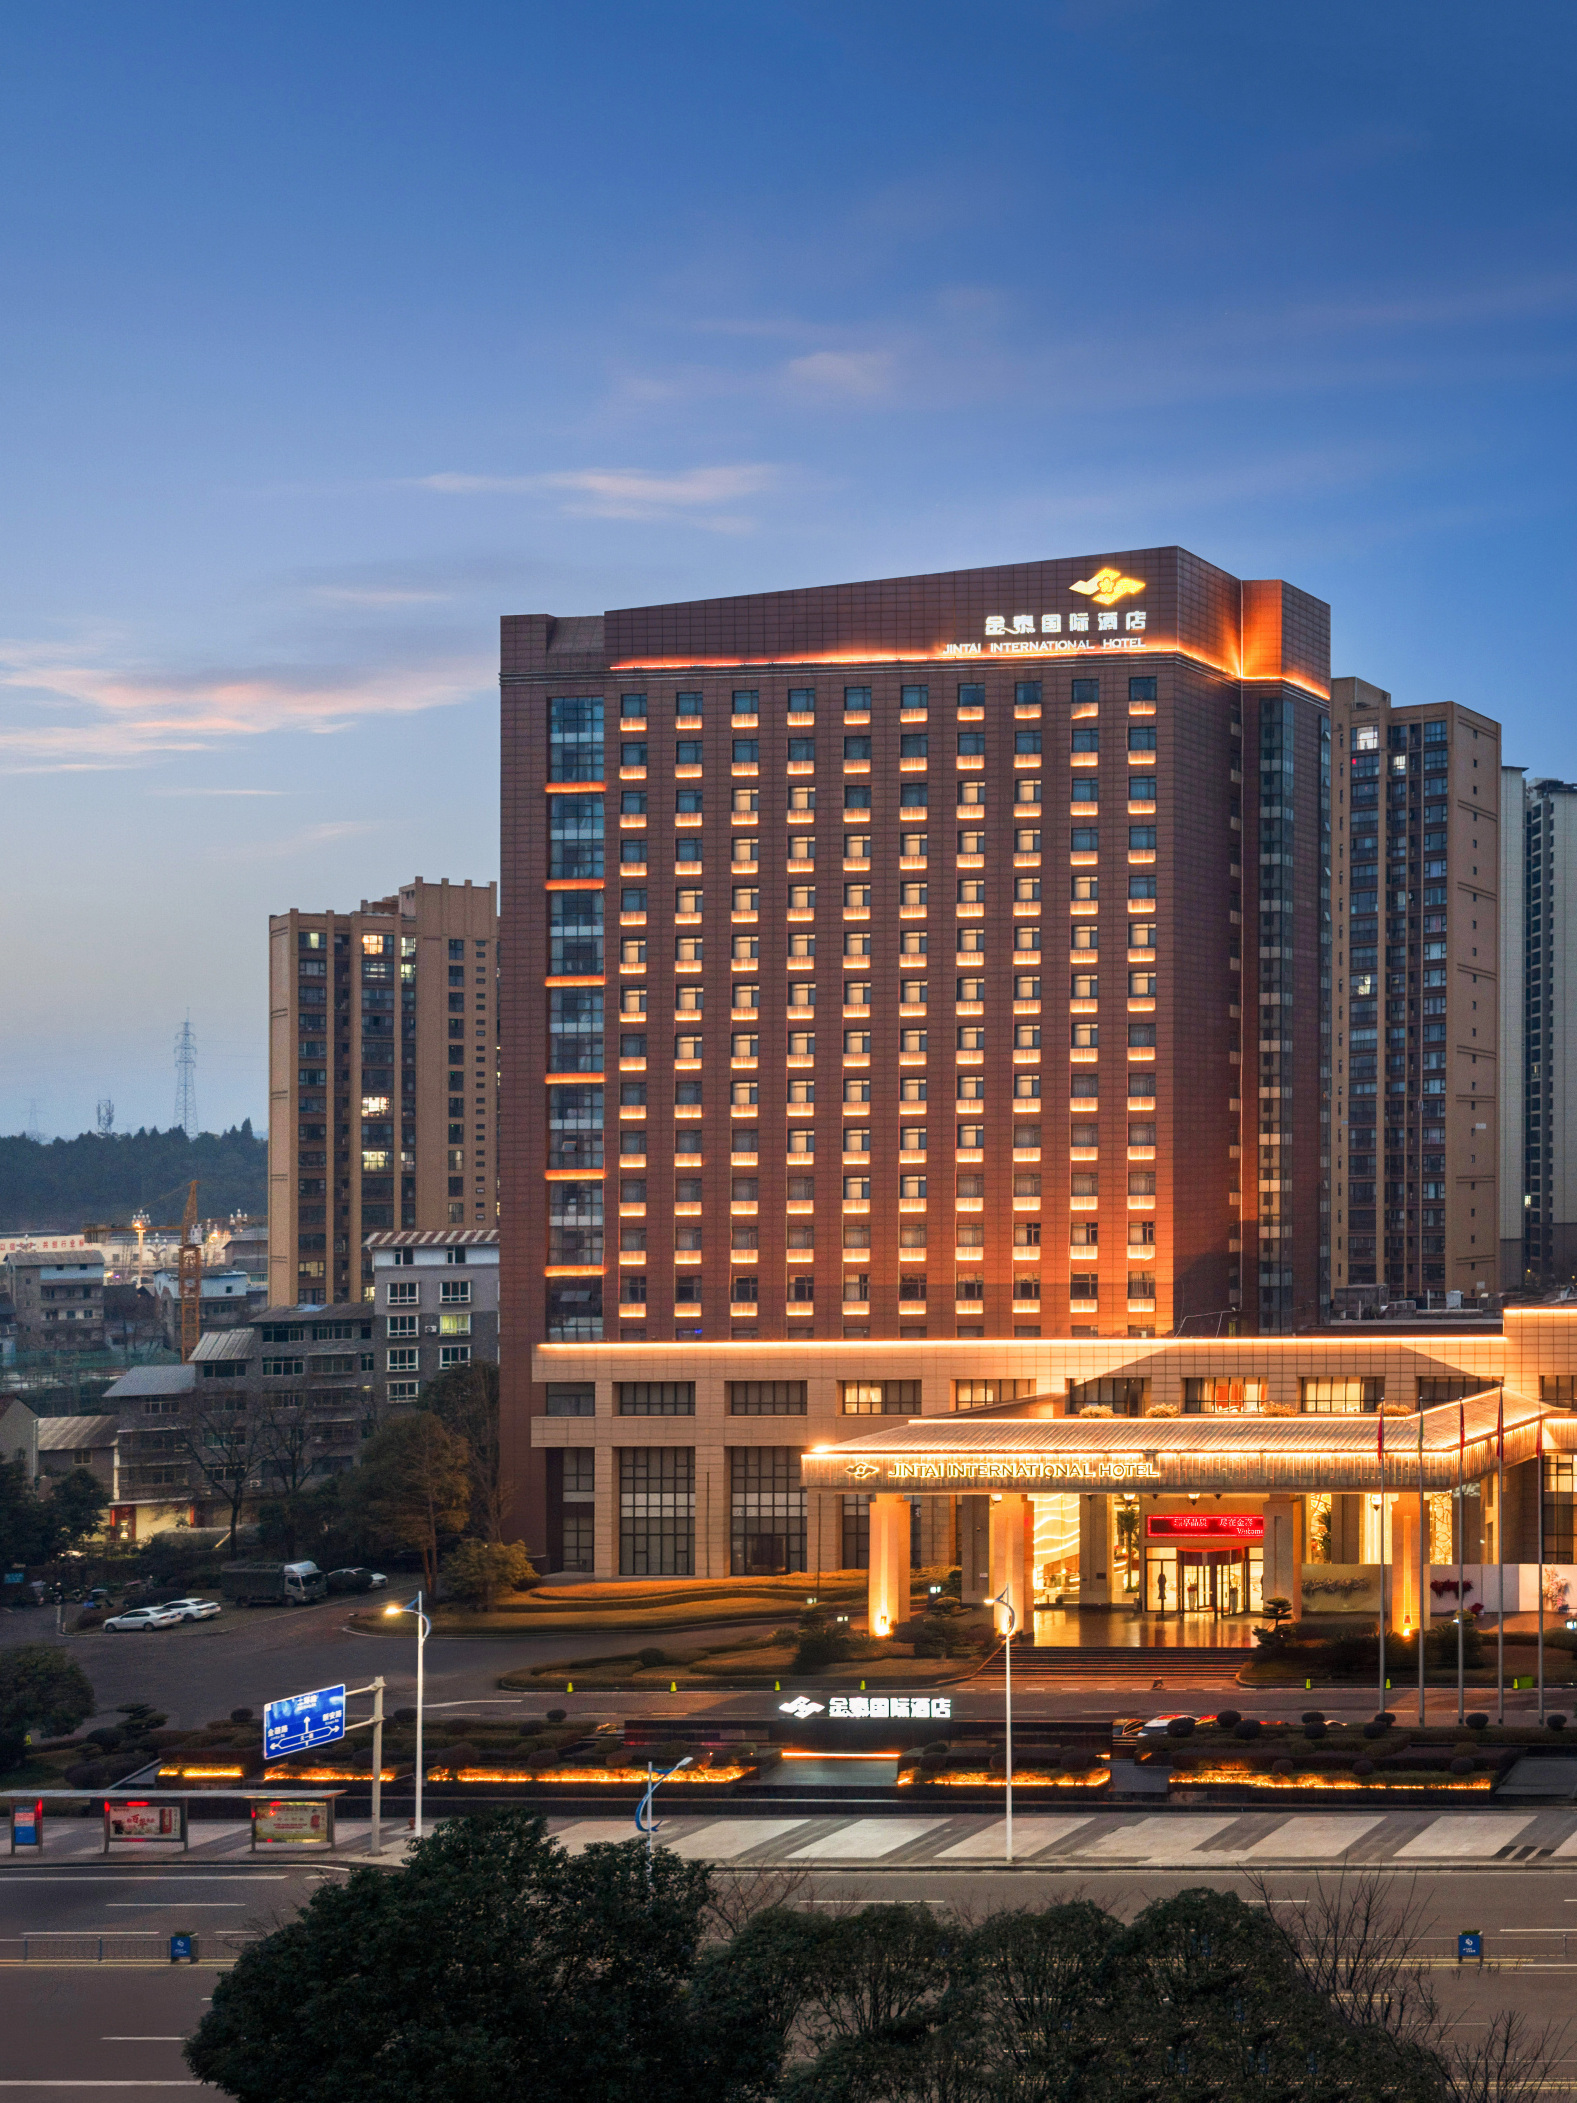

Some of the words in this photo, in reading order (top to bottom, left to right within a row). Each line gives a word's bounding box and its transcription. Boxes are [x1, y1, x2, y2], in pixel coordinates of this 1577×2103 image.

[984, 610, 1147, 636] 金泰国际酒店
[943, 642, 982, 655] JINTAI
[990, 639, 1095, 653] INTERNATIONAL
[1102, 637, 1147, 649] HOTEL
[888, 1463, 945, 1478] JINTAI
[947, 1463, 1097, 1478] INTERNATIONAL
[1099, 1463, 1160, 1478] HOTEL
[829, 1697, 951, 1718] 金泰国际酒店
